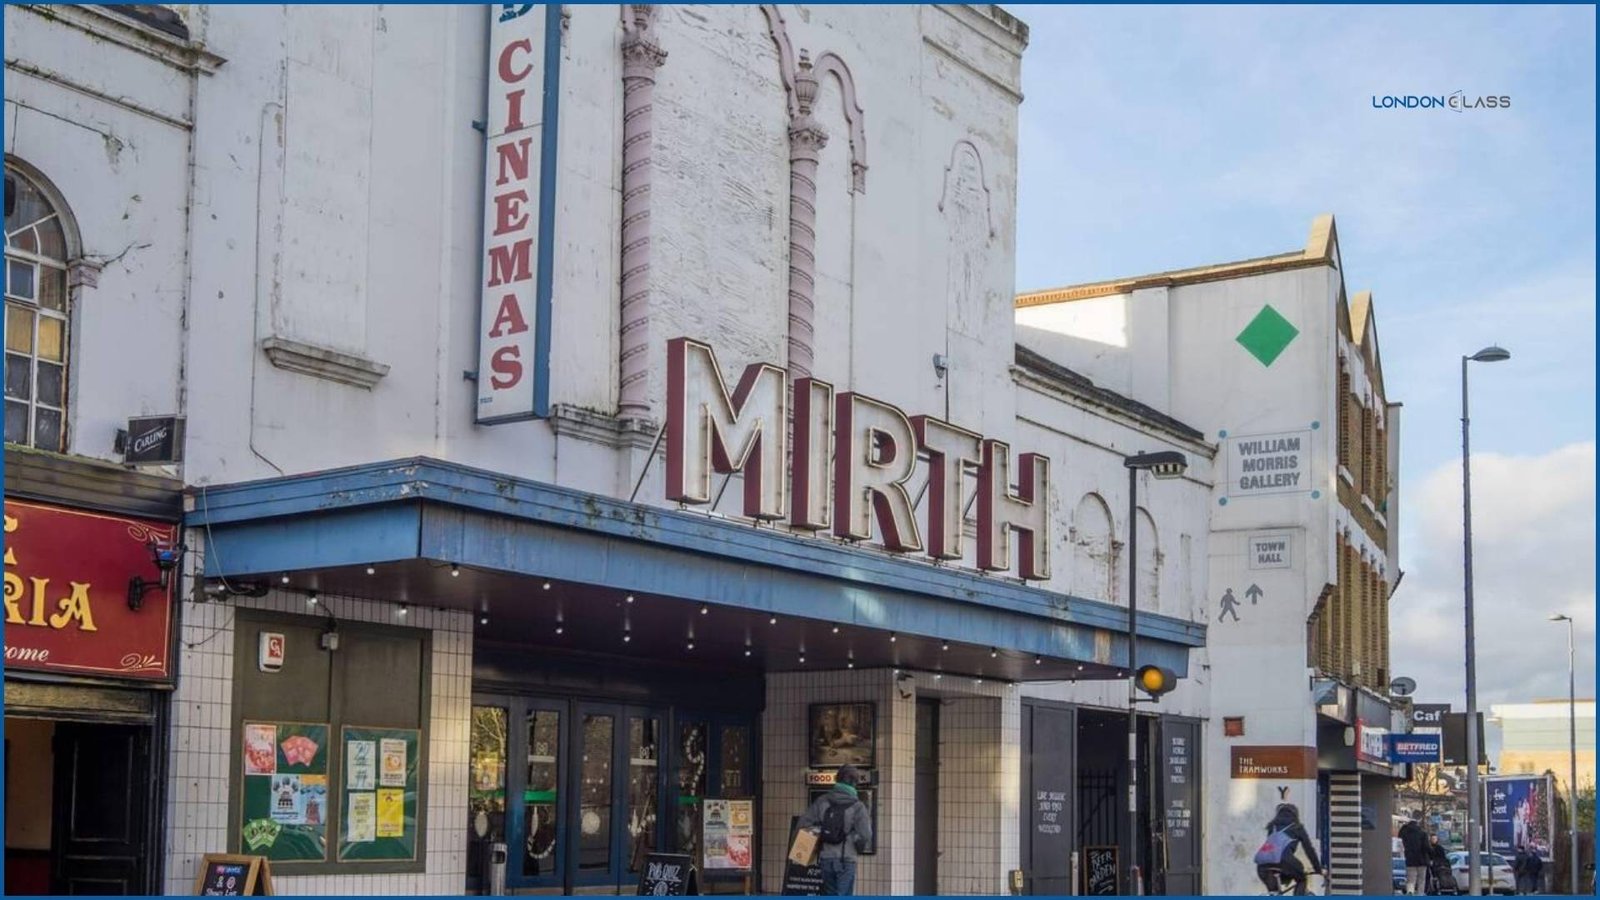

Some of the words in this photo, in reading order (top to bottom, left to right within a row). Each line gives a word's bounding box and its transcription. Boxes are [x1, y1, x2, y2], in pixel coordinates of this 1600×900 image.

[488, 38, 533, 391] CINEMAS
[134, 427, 167, 452] CARLING
[1238, 437, 1301, 456] WILLIAM
[665, 337, 1051, 582] MIRTH
[1242, 455, 1299, 472] MORRIS
[1239, 472, 1301, 490] GALLERY
[1255, 541, 1286, 552] TOWN
[1258, 553, 1283, 564] HALL
[1413, 709, 1448, 722] Caf
[1396, 743, 1438, 751] BETFRED
[1239, 757, 1254, 766] THE
[1239, 766, 1289, 774] TRAMWORKS
[810, 774, 832, 782] FOOD
[1277, 785, 1289, 799] Y
[1092, 851, 1113, 871] BEER
[1089, 863, 1116, 890] GARDEN
